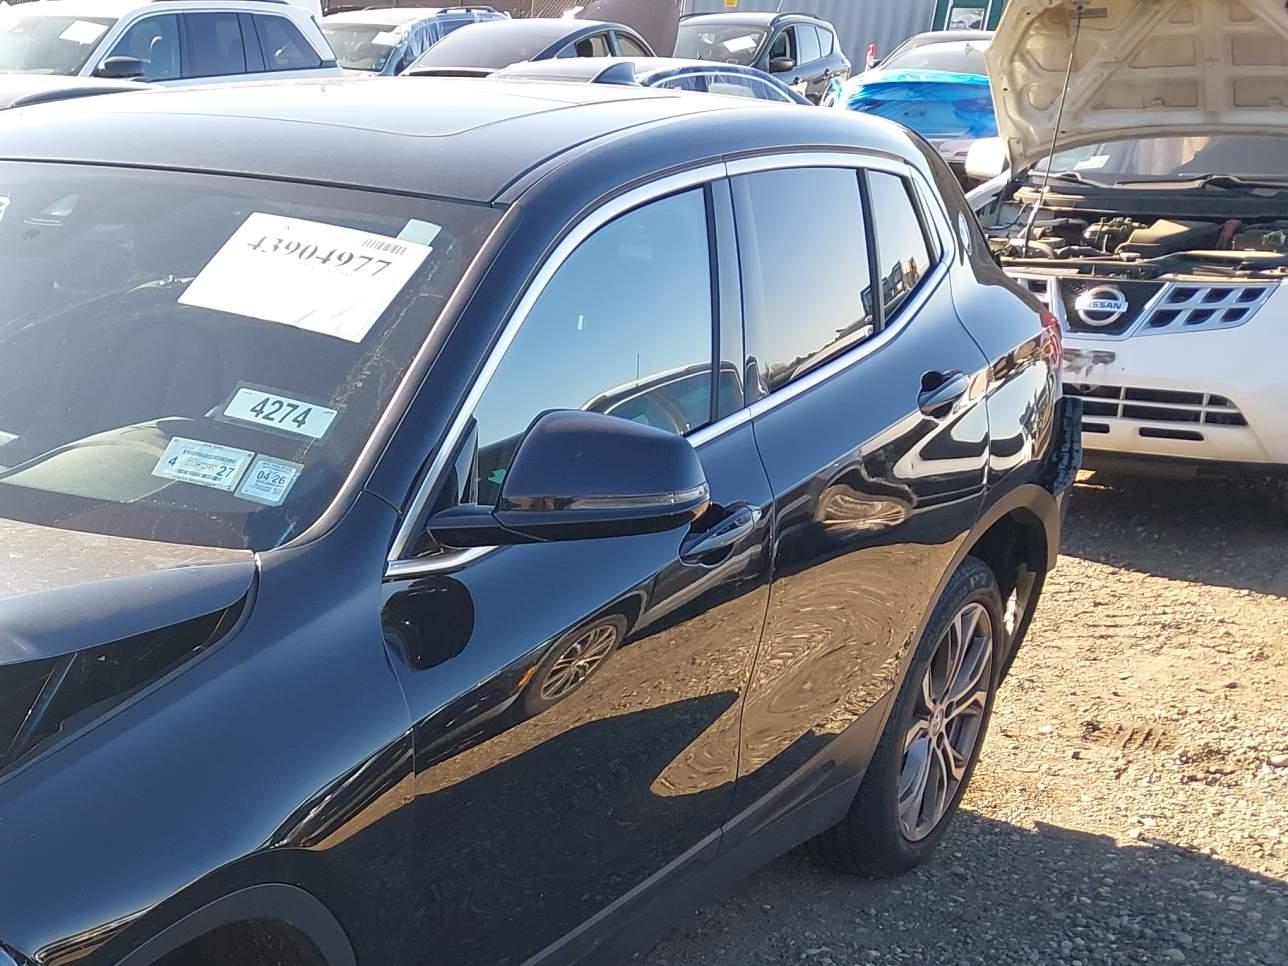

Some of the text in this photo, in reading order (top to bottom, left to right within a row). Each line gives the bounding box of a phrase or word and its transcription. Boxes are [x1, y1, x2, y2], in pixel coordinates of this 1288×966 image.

[247, 235, 393, 277] 43904977
[249, 397, 313, 428] 4274
[168, 456, 178, 466] 4
[216, 466, 236, 478] 27
